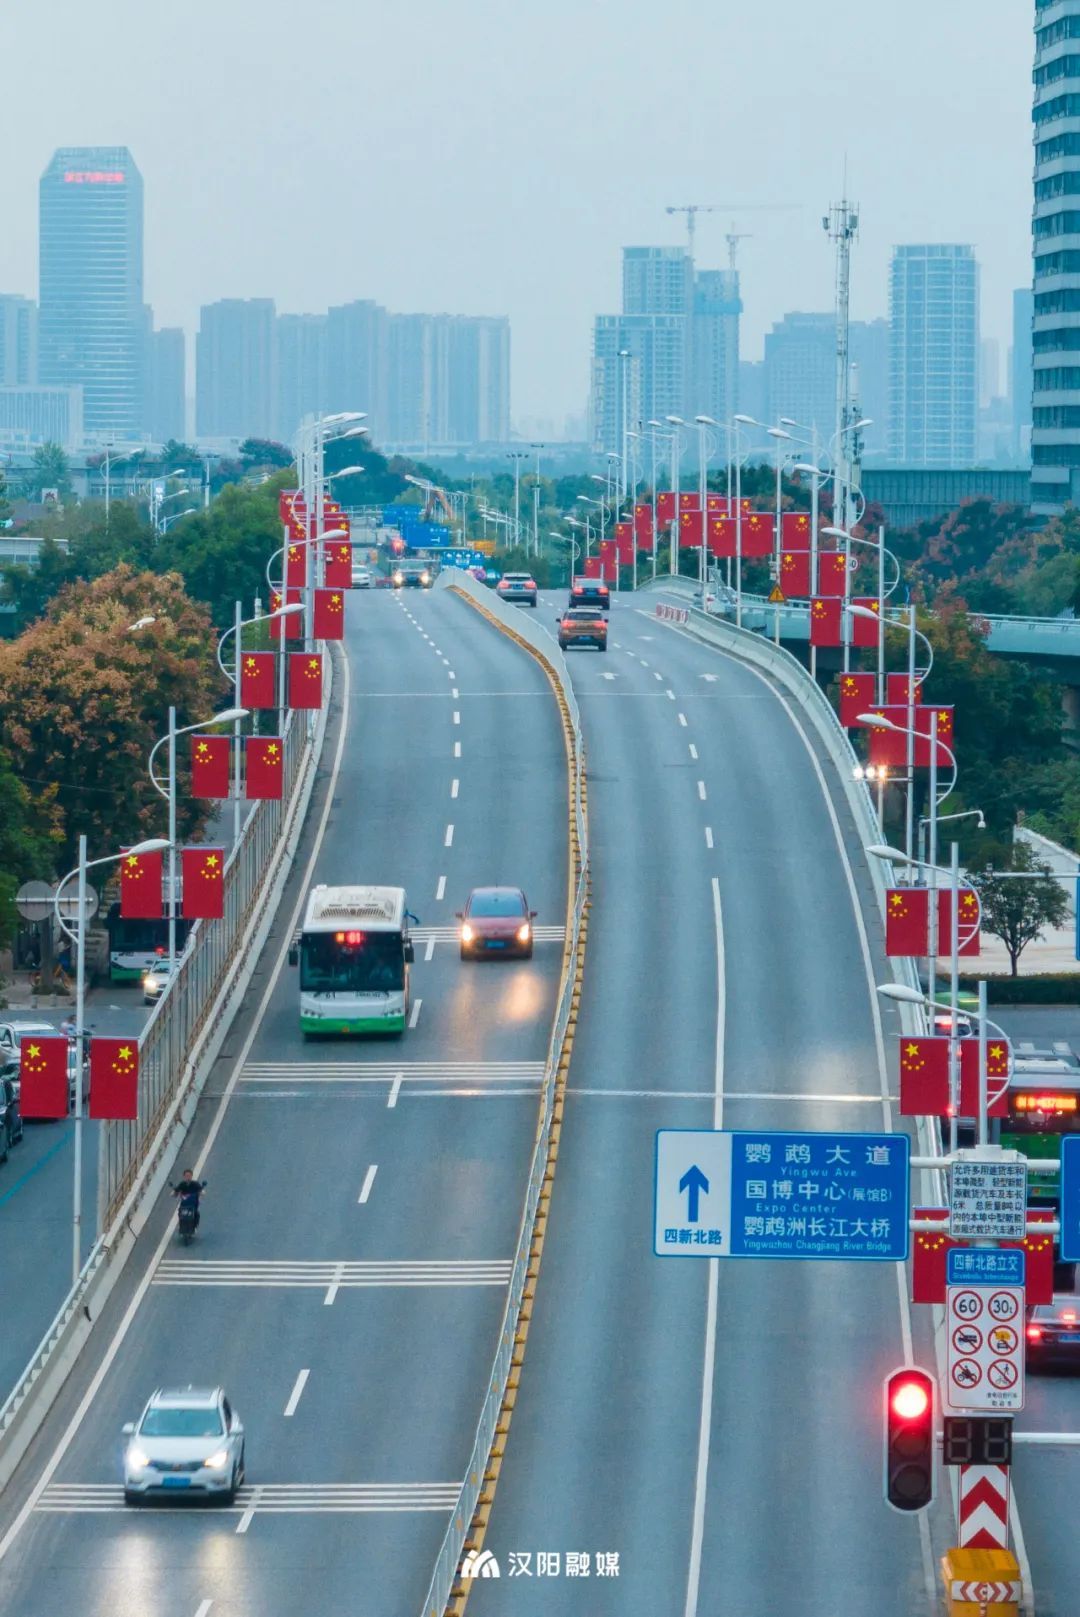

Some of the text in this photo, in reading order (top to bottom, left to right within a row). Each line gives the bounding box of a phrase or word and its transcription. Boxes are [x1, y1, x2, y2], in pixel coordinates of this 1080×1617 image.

[745, 1143, 891, 1165] 鹦鹉大道
[780, 1166, 828, 1178] Yingwu
[756, 1203, 836, 1214] Expo Center
[744, 1216, 890, 1238] 鹦鹉洲长江大桥
[664, 1229, 722, 1245] 四新北路
[743, 1239, 892, 1253] Yingwuzhou Changjiang River Bridge
[954, 1253, 1018, 1271] 四新北路立交
[959, 1299, 978, 1313] 60
